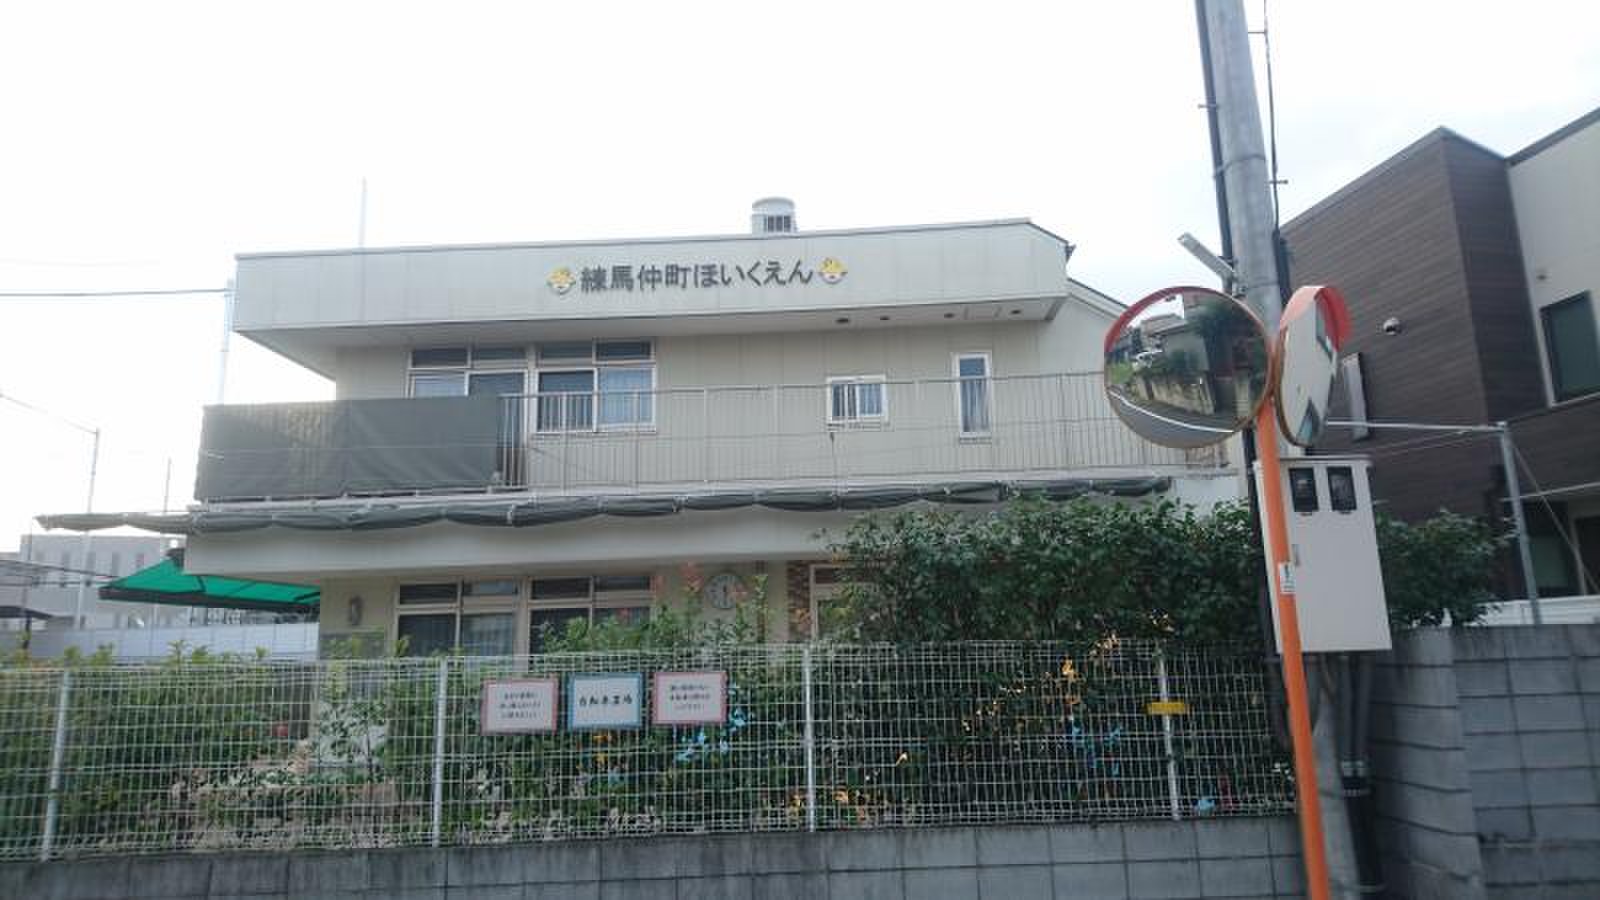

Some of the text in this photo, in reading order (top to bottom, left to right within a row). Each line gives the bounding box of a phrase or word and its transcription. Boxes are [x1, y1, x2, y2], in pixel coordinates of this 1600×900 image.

[580, 259, 814, 294] 練馬仲町ほいくえん
